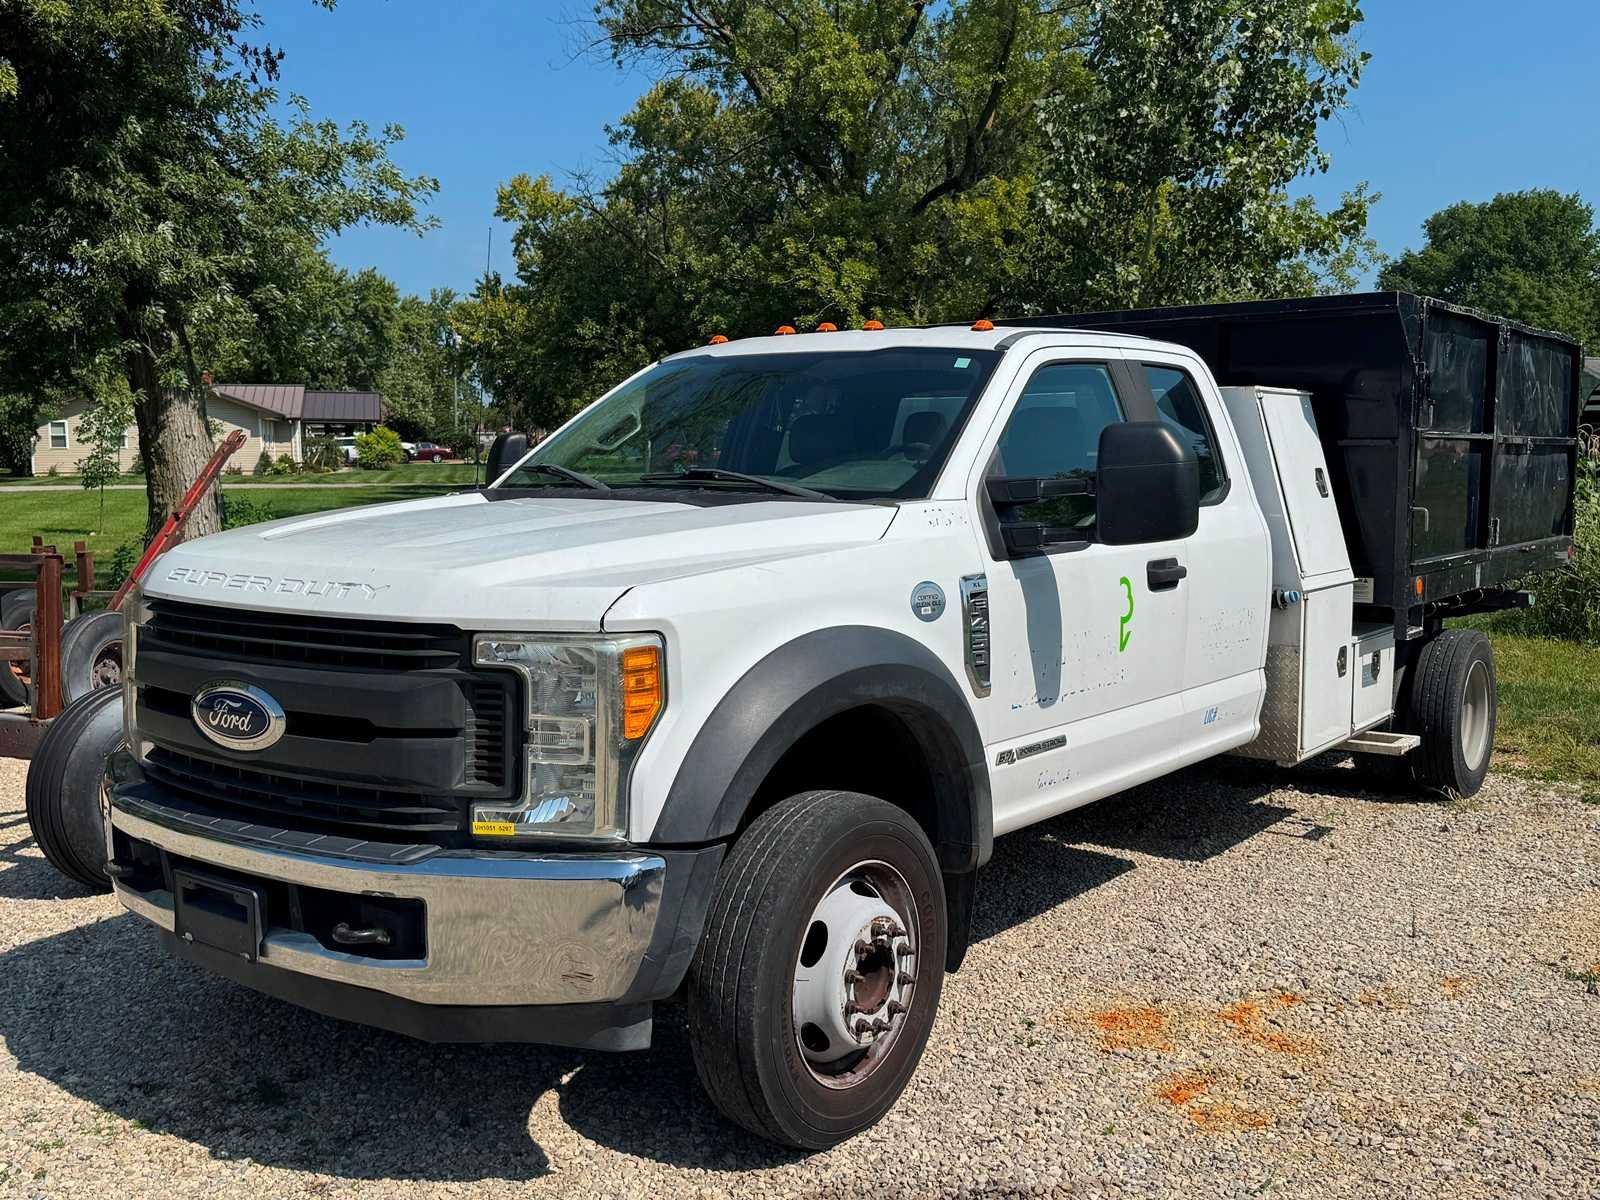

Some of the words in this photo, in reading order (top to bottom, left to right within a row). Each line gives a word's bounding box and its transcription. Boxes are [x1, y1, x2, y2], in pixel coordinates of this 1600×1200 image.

[165, 567, 272, 593] SUPER
[274, 578, 391, 600] DUTY
[209, 698, 252, 731] Ford
